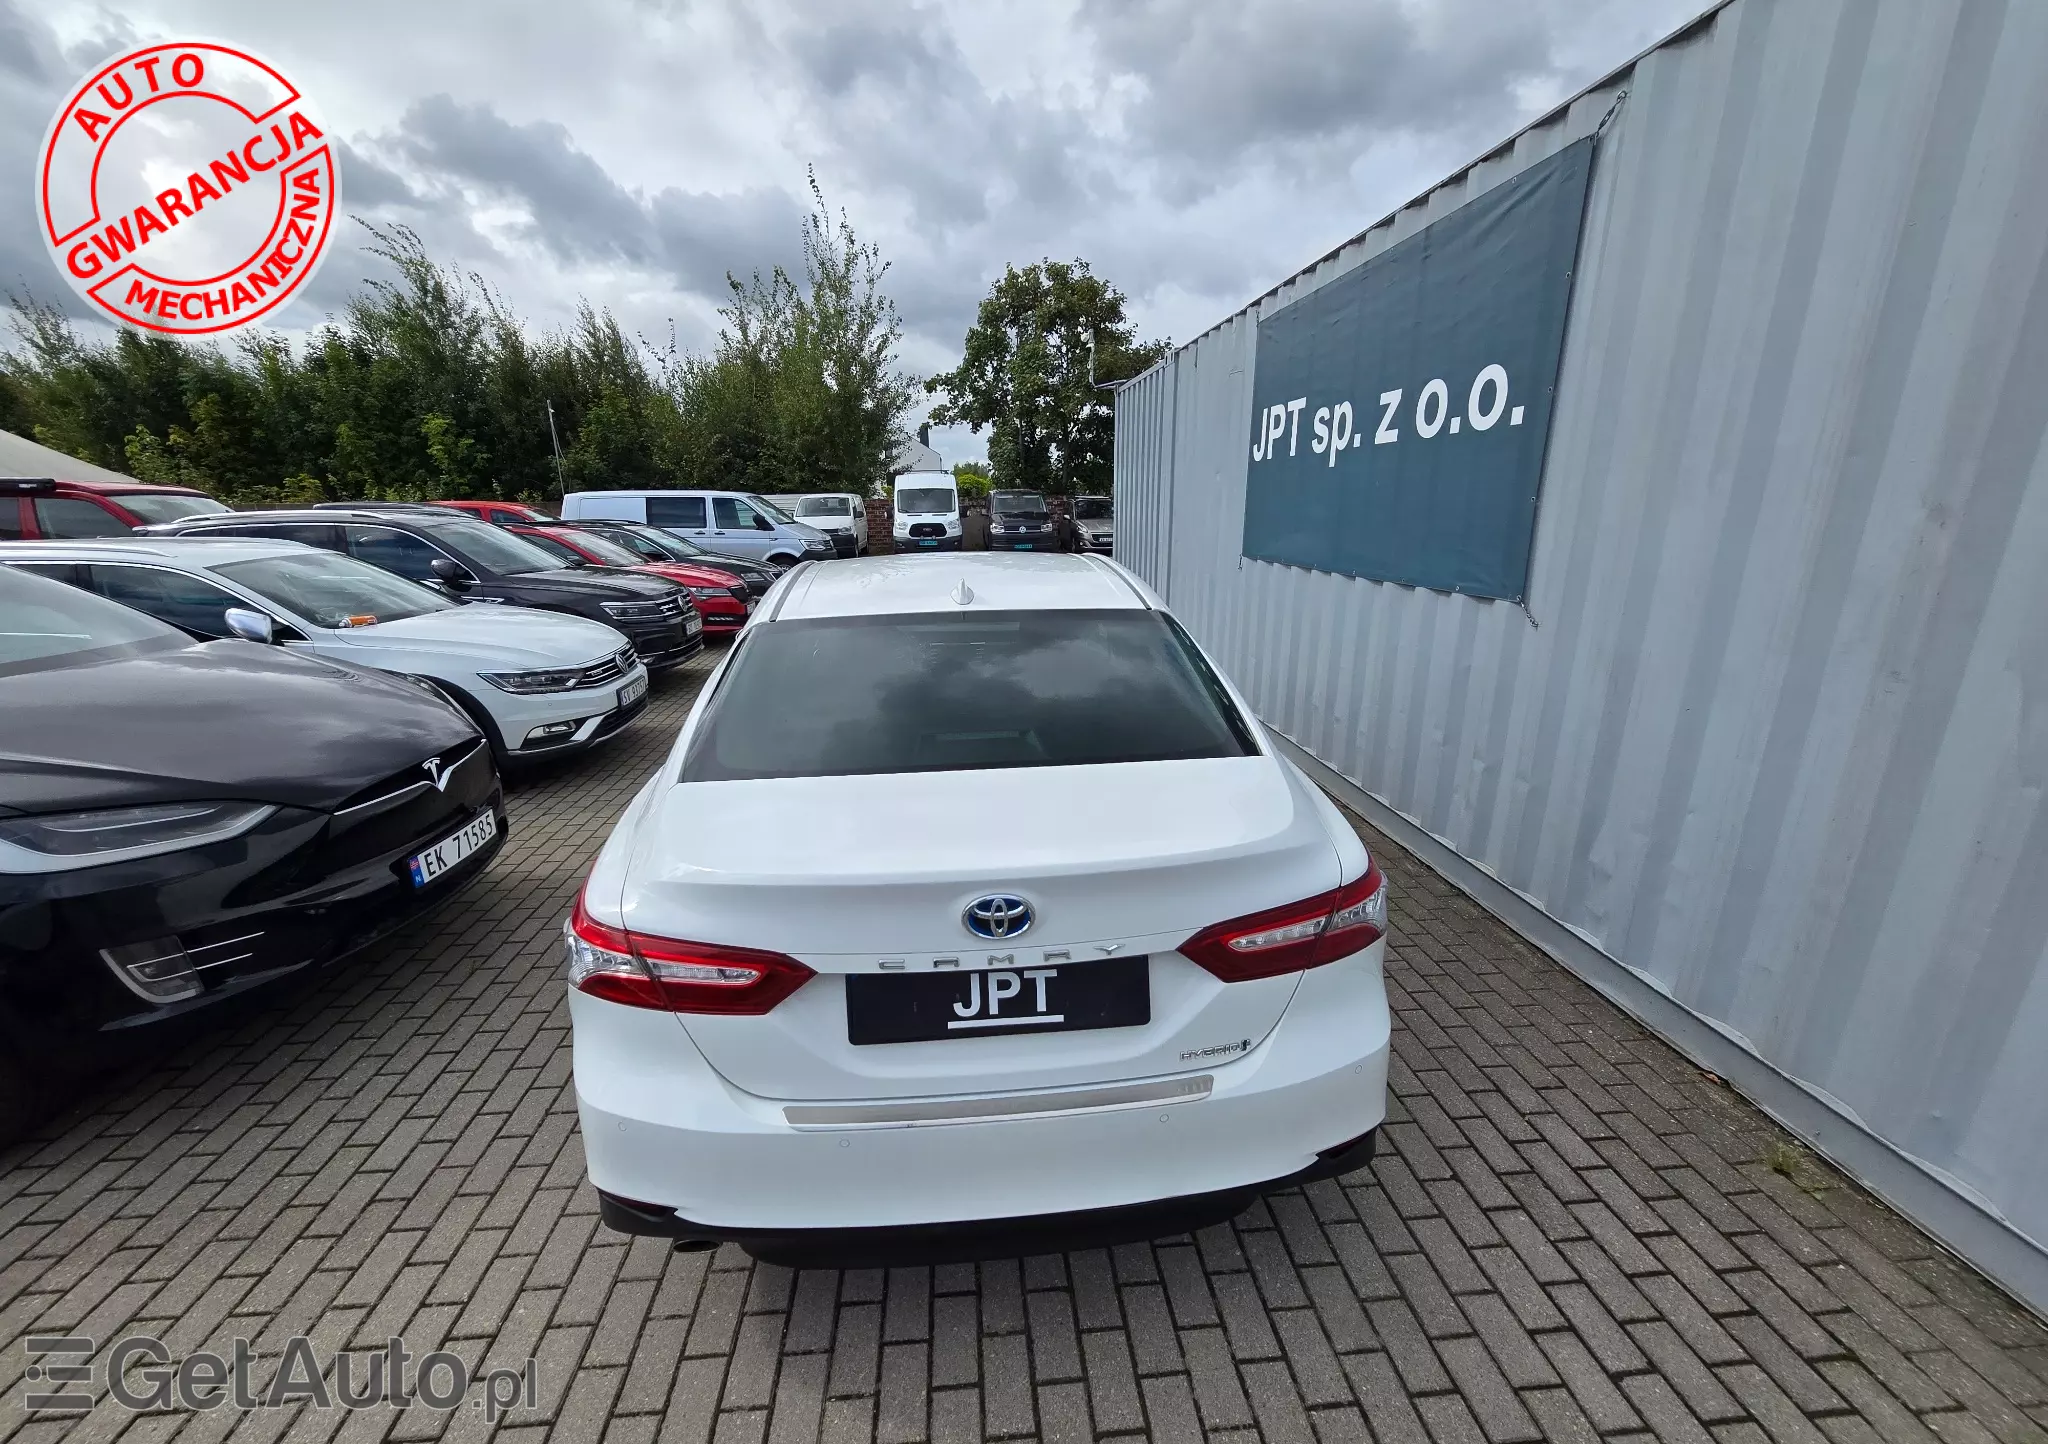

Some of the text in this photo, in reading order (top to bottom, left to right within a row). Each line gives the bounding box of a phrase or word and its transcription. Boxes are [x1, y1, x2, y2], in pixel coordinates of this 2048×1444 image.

[1253, 397, 1307, 462] JPT
[1312, 400, 1362, 468] sp.
[424, 814, 493, 877] EK 71585
[878, 943, 1126, 970] CAMRY
[952, 968, 1058, 1018] JPT
[1180, 1042, 1240, 1060] HYBRID
